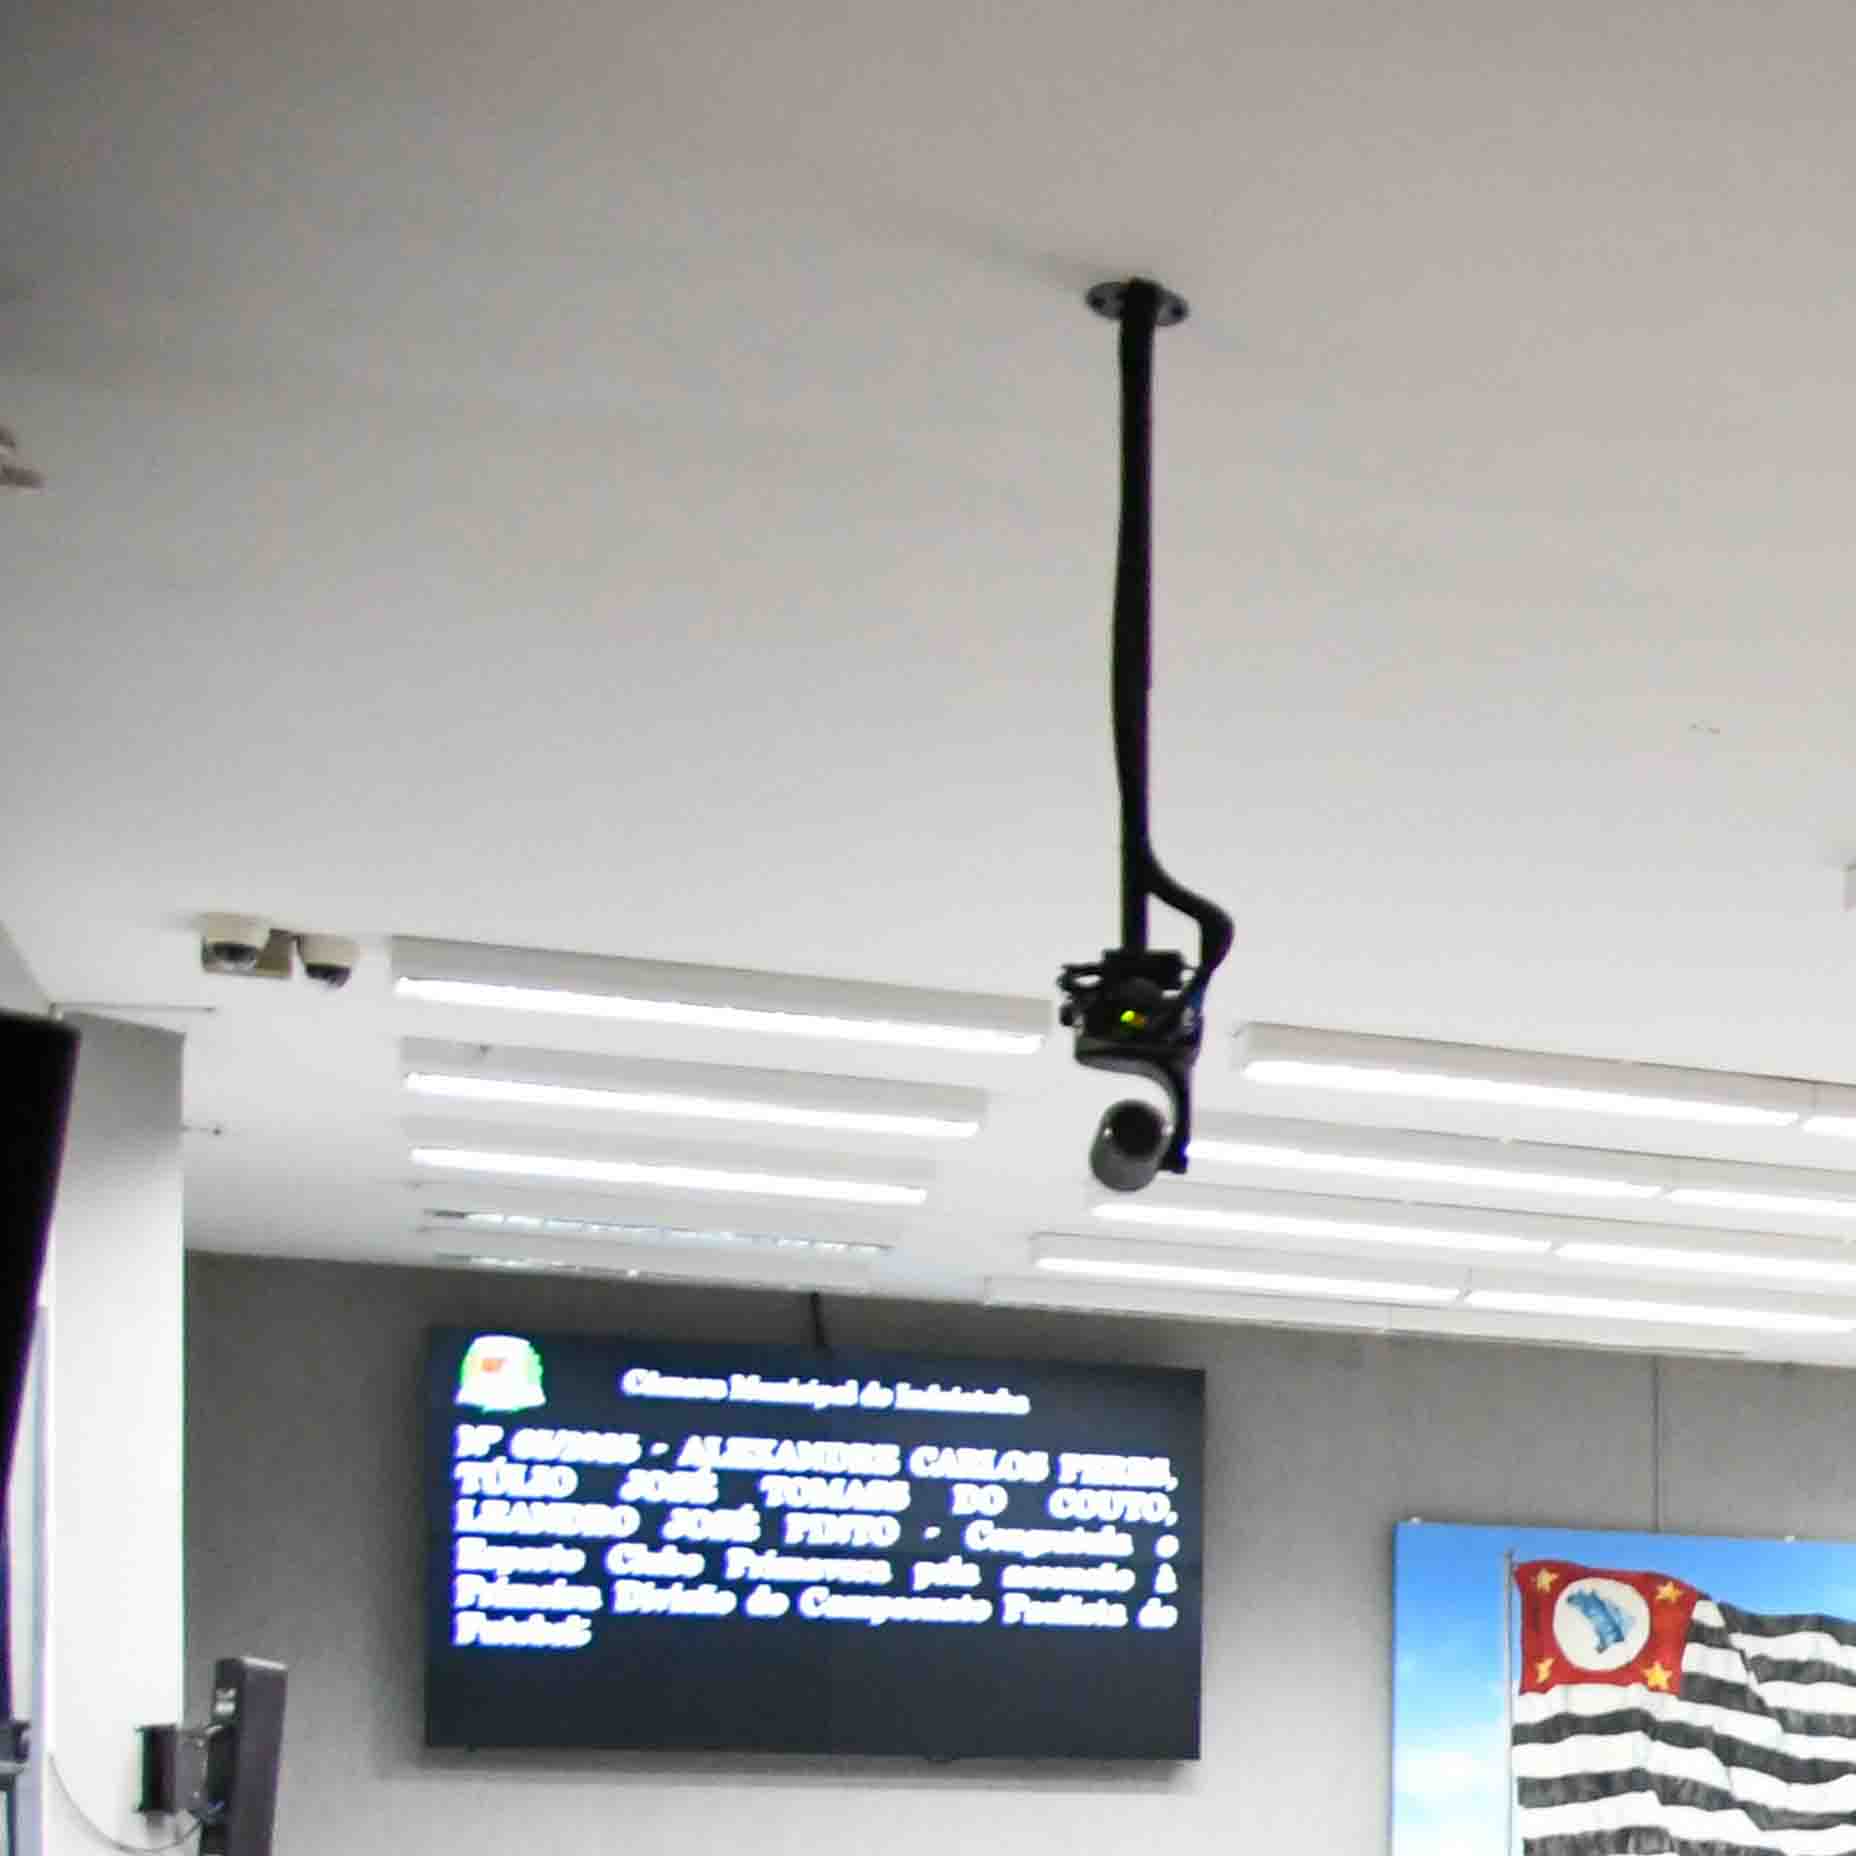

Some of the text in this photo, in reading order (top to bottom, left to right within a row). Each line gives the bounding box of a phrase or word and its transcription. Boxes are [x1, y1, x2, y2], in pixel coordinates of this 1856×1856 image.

[679, 1436, 900, 1476] ALEXANDRE
[910, 1446, 1049, 1482] CARLOS
[455, 1456, 577, 1497] TÚLIO
[620, 1467, 718, 1504] JOSÉ
[952, 1484, 1008, 1516] DO
[1049, 1488, 1178, 1526] COUTO,
[456, 1499, 640, 1537] LEANDRO
[663, 1504, 760, 1542] JOSÉ
[785, 1513, 900, 1547] PINTO
[726, 1547, 892, 1584] Primavera
